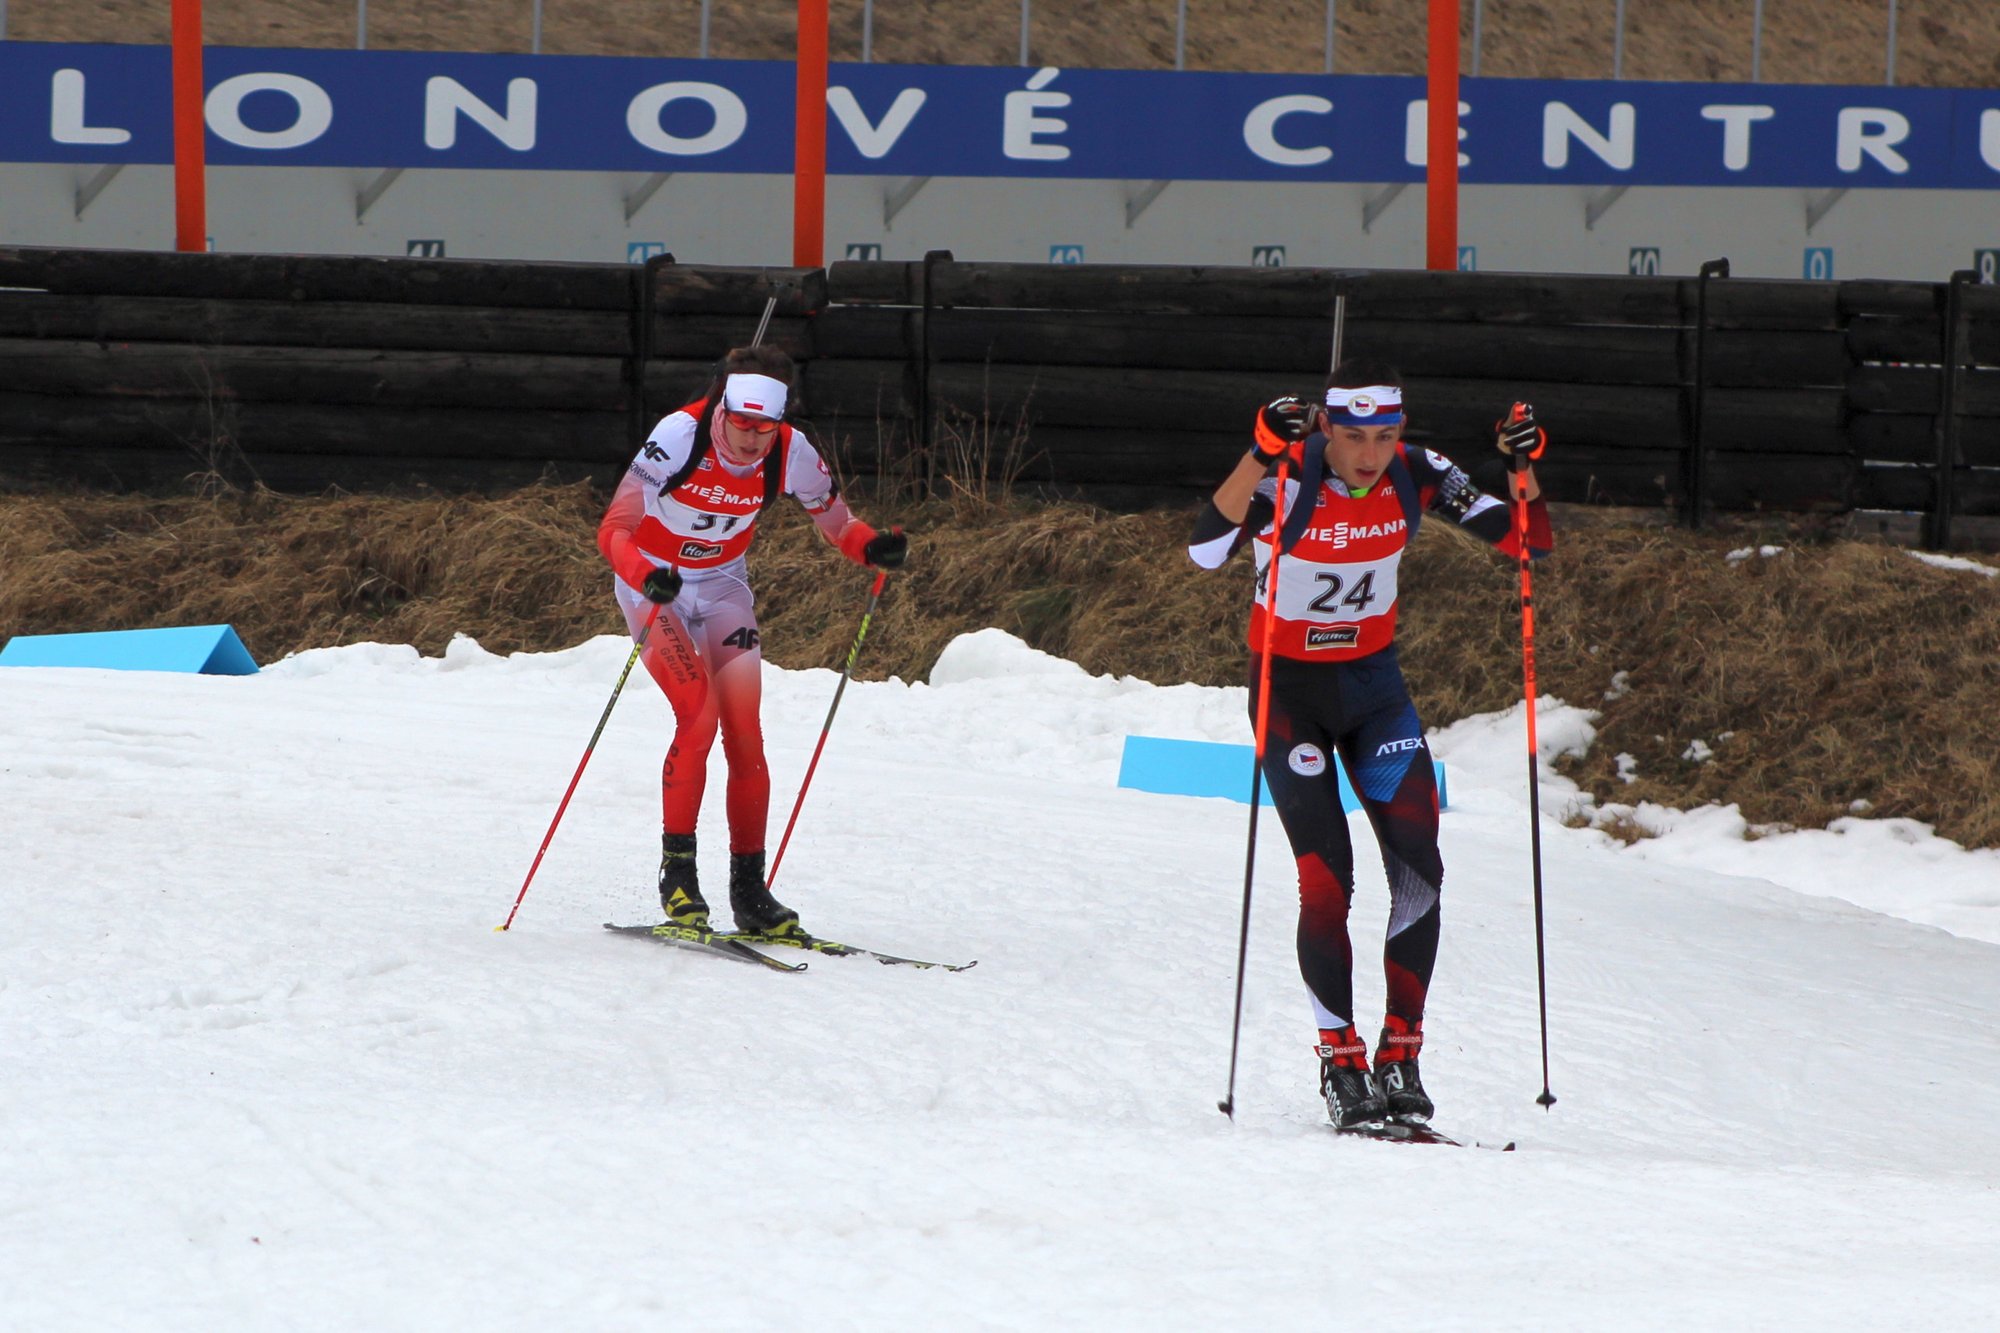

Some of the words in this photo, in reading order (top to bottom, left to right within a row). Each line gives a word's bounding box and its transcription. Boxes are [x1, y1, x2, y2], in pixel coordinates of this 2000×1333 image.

[681, 483, 764, 505] VIESSMAN
[1307, 569, 1376, 614] 24
[656, 615, 700, 681] PIETRZAK
[1376, 738, 1424, 757] ATEX
[1334, 1045, 1366, 1055] ROSSIGNO
